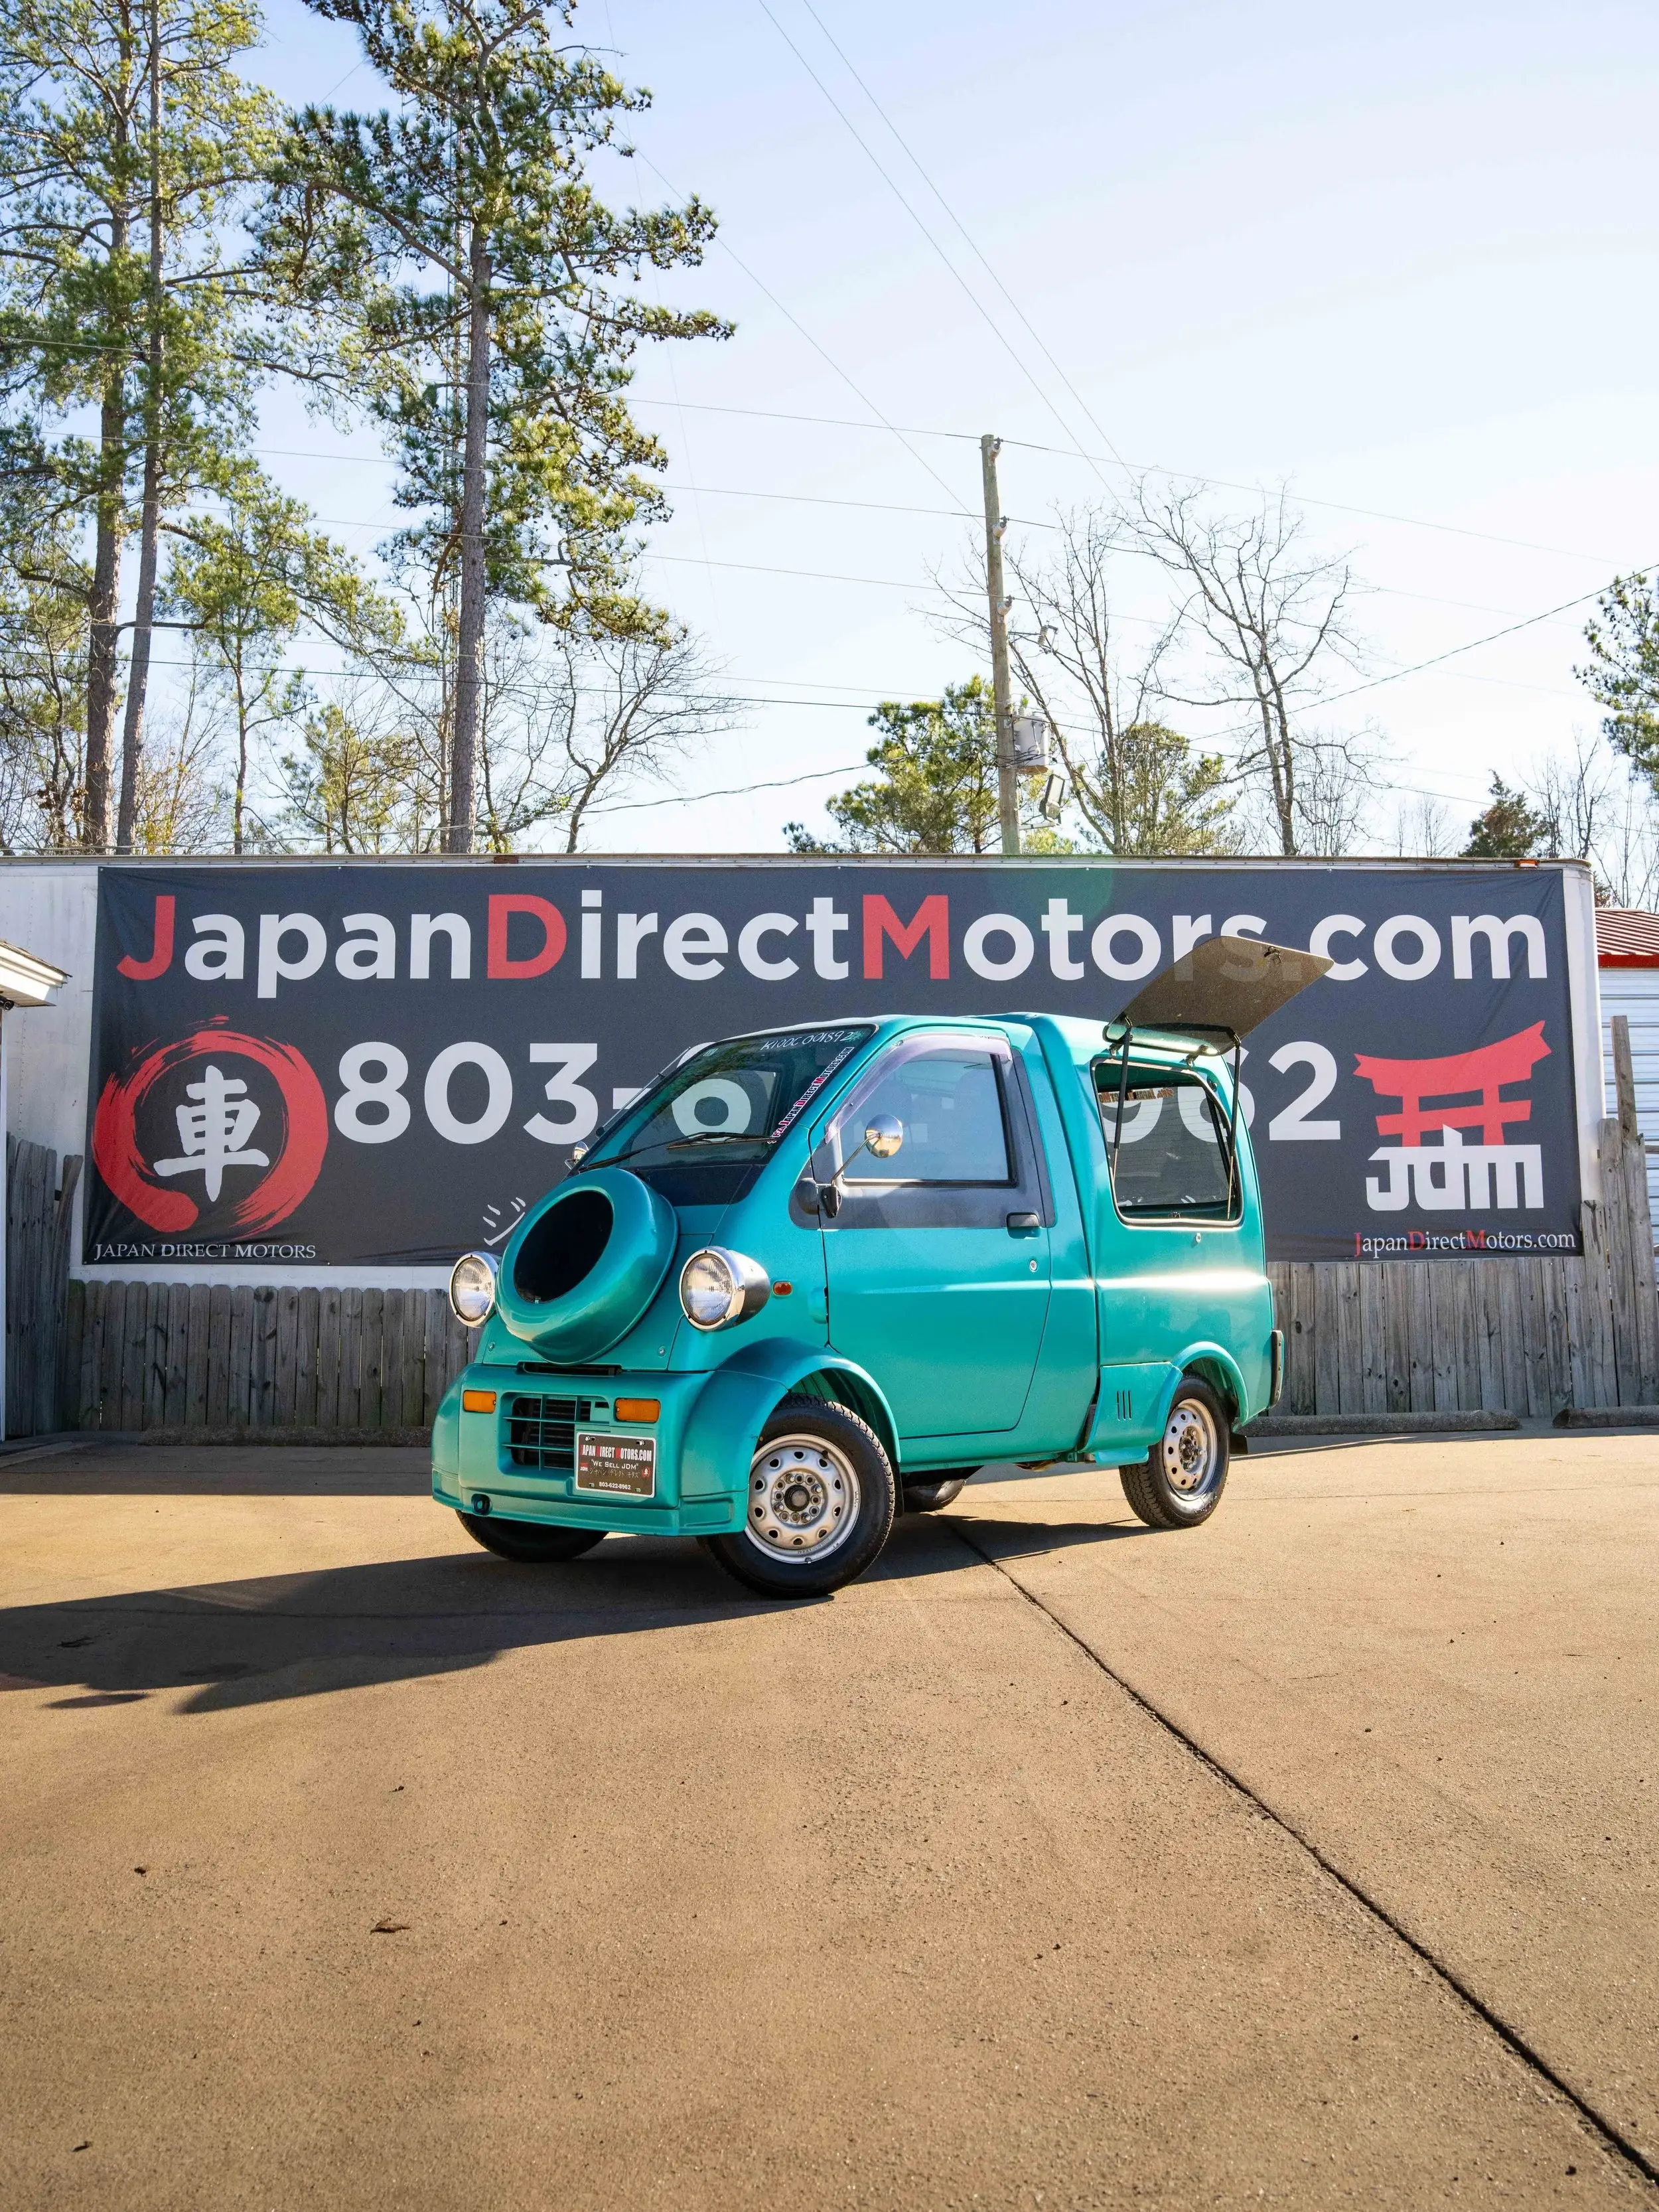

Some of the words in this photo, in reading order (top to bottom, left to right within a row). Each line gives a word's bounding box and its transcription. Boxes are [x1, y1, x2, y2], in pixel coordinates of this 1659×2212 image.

[153, 1065, 269, 1202] 車
[94, 1244, 155, 1260] JAPAN
[161, 1244, 230, 1258] DIRECT
[234, 1244, 316, 1258] MOTORS
[1354, 1229, 1577, 1259] JapanDirectMotors.com
